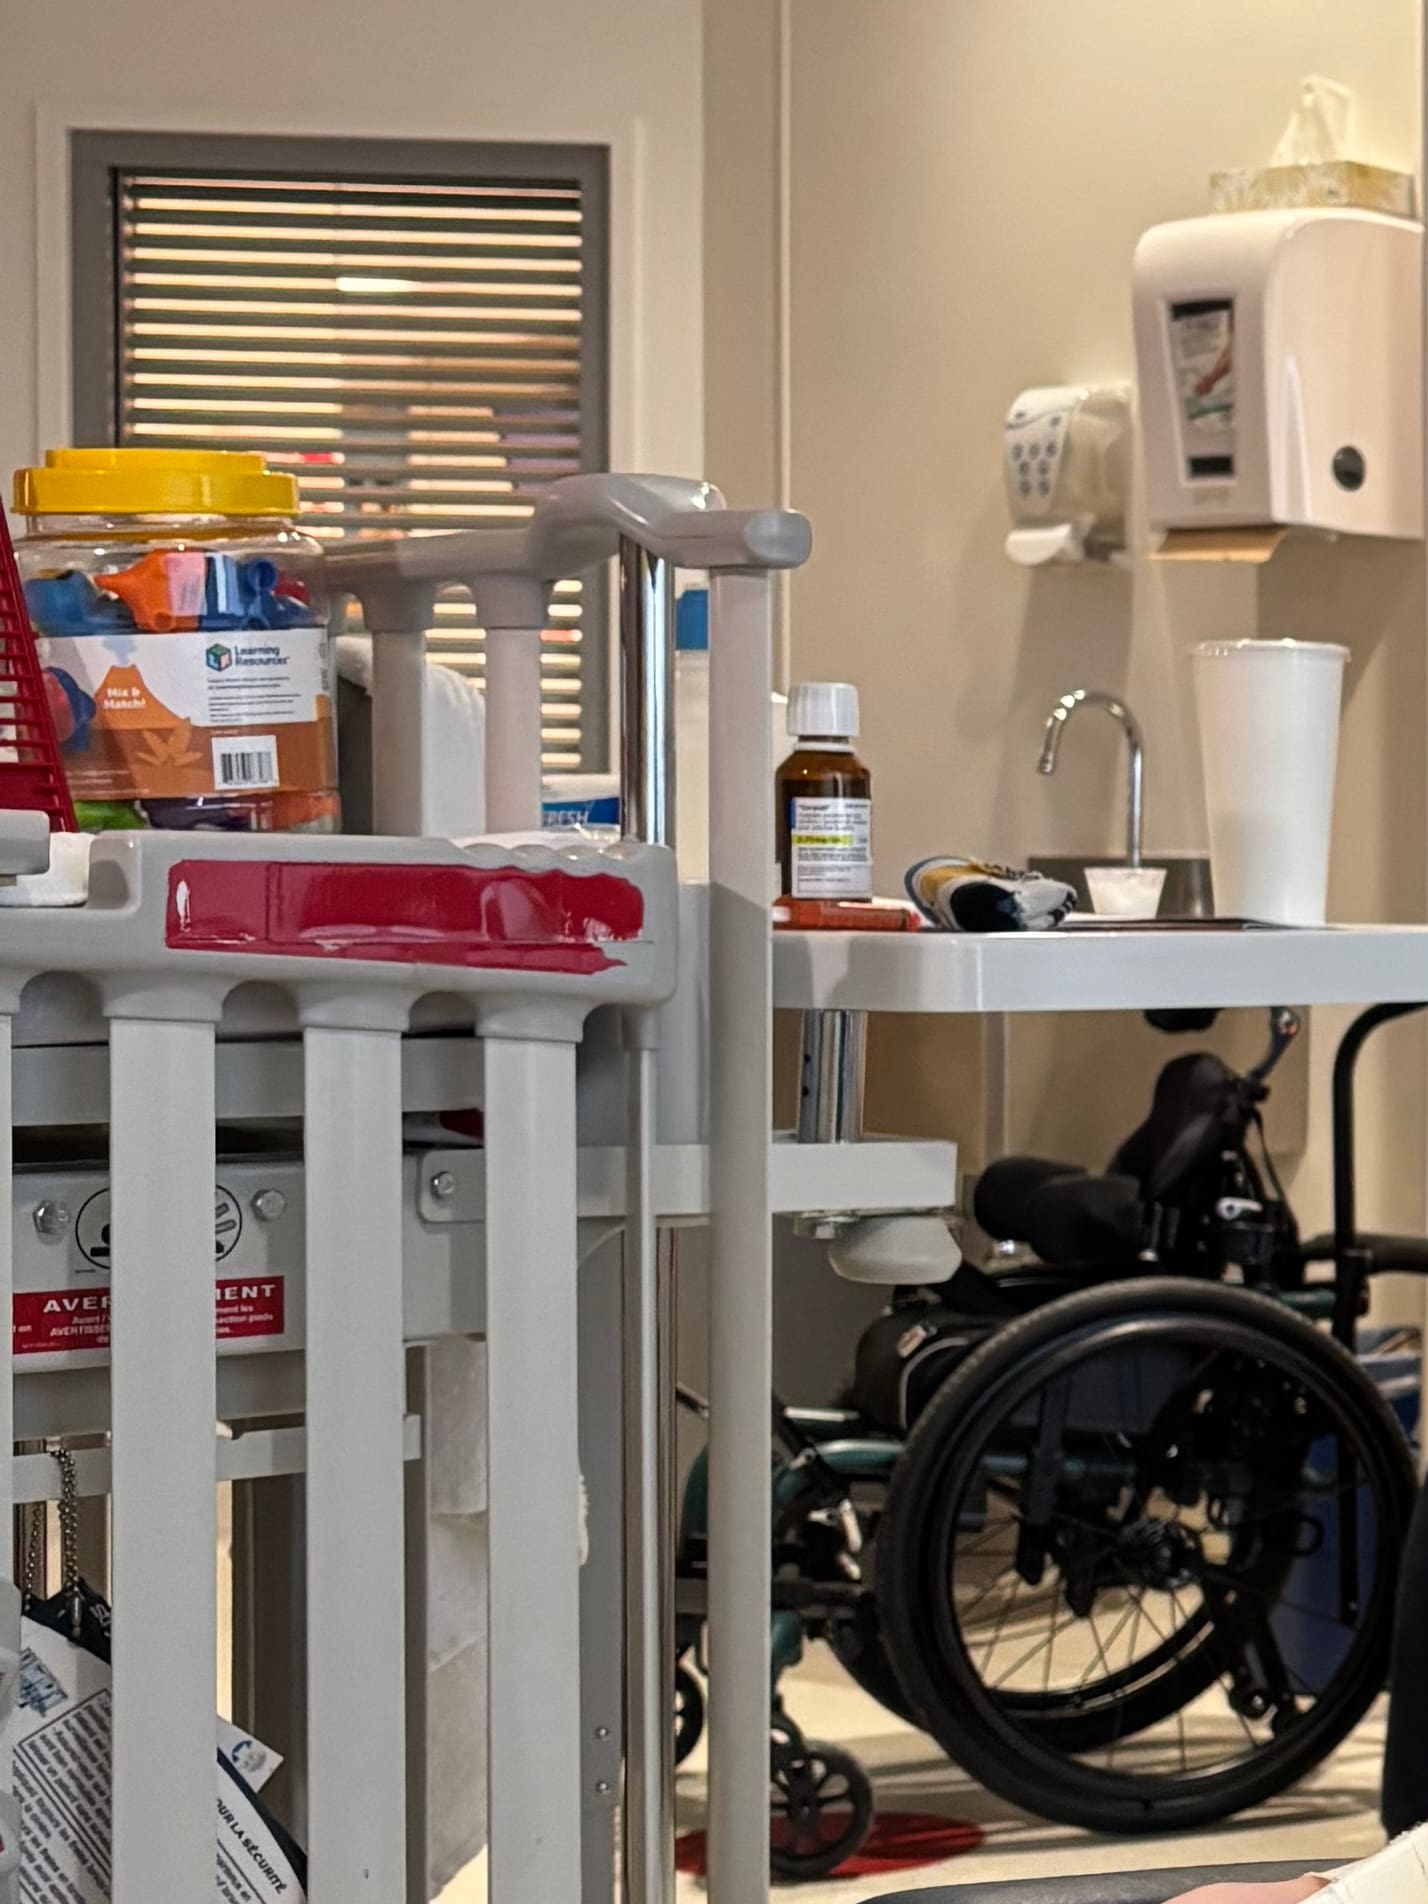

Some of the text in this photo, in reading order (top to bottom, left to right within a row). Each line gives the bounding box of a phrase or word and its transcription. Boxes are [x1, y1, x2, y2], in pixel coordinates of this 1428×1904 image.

[235, 645, 280, 658] Learning
[107, 687, 130, 698] Mix
[103, 699, 147, 711] Match!
[239, 1834, 289, 1895] SÉCURITÉ
